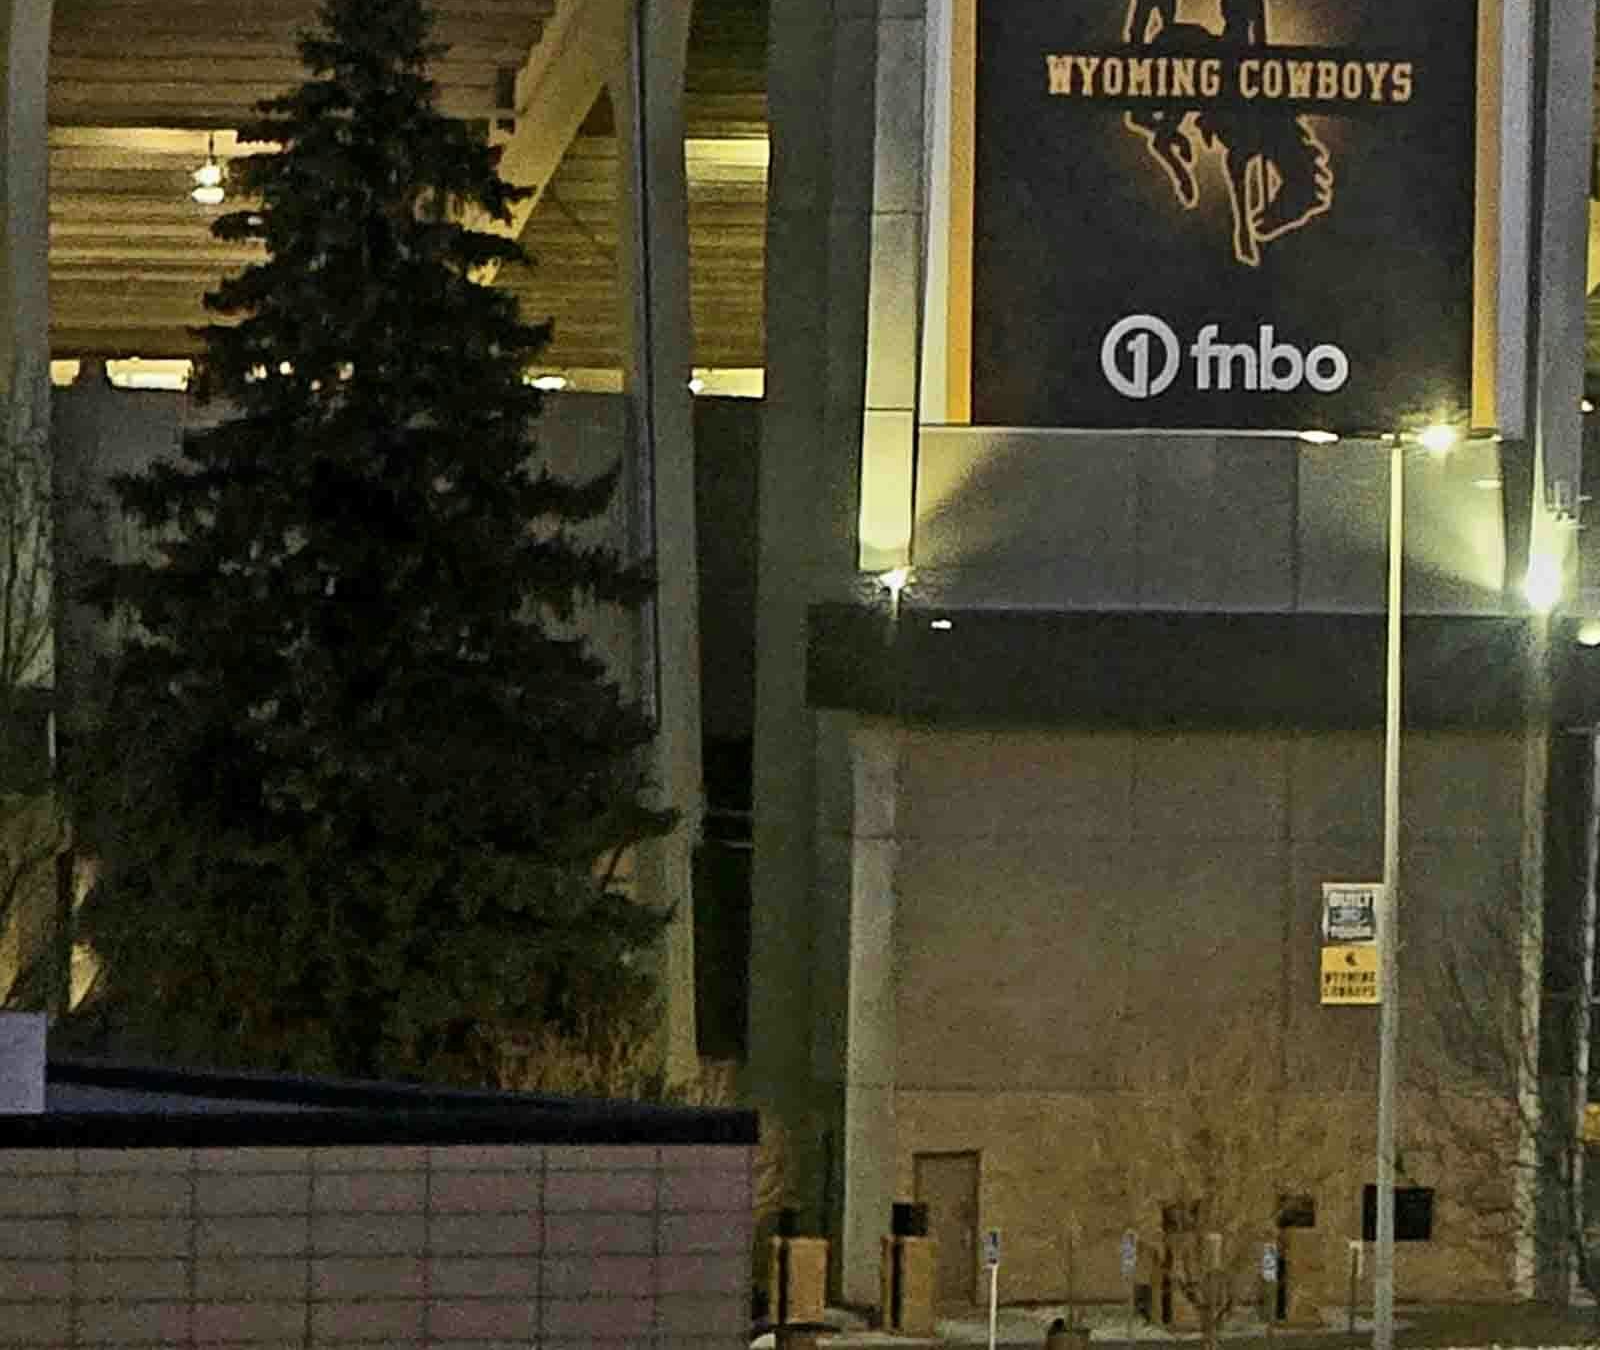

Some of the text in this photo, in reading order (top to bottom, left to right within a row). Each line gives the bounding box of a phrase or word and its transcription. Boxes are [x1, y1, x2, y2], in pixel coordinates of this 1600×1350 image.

[1046, 54, 1413, 102] WYOMING COWBOYS
[1189, 324, 1350, 392] fnbo
